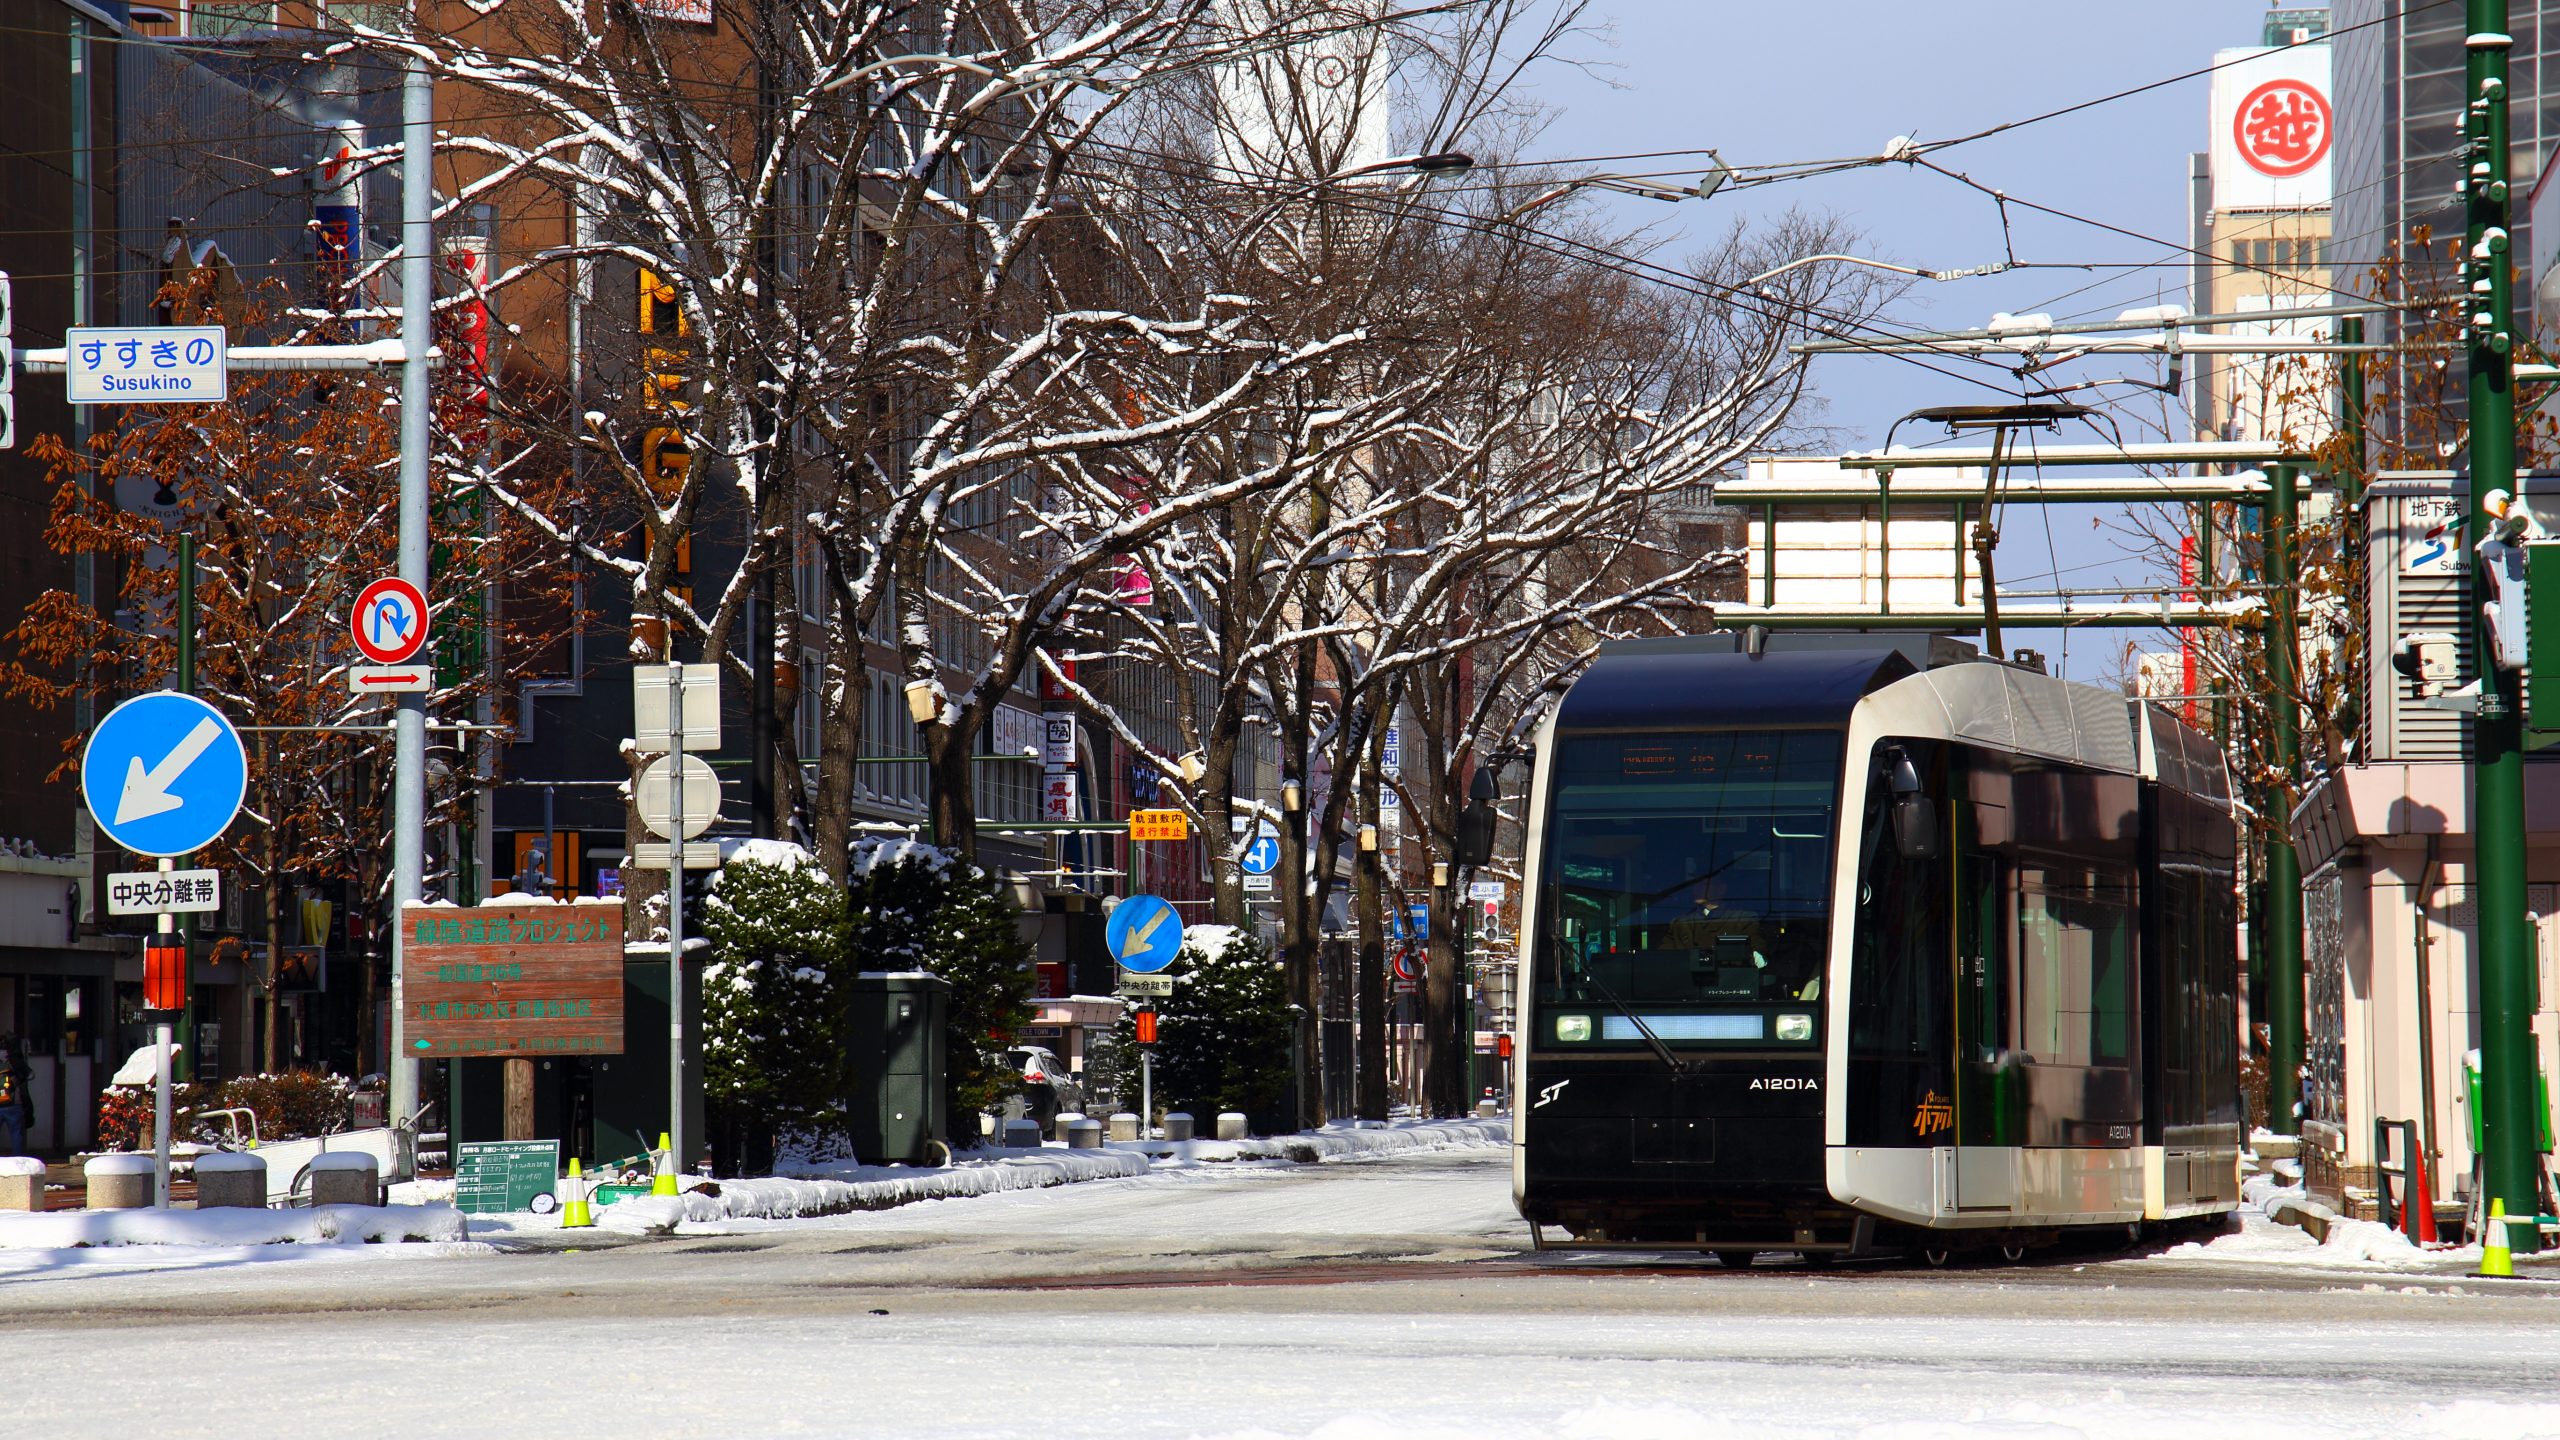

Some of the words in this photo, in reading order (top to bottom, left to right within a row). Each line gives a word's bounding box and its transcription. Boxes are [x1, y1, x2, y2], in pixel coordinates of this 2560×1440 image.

[79, 337, 215, 369] すすきの
[102, 373, 192, 391] Susukino
[2411, 501, 2462, 517] 地下鉄
[1135, 813, 1183, 824] 軌道敷内
[1135, 827, 1184, 838] 通行禁止
[113, 878, 214, 907] 中央分離帯
[415, 915, 612, 945] 緑陰道路プロジェクト
[424, 963, 522, 982] 一般国道36号
[1120, 981, 1172, 992] 中央分離帯
[420, 1000, 511, 1020] 札幌市中央区
[516, 999, 593, 1018] 四番街地区
[1749, 1077, 1819, 1090] A1201A
[2109, 1125, 2132, 1140] A1201A
